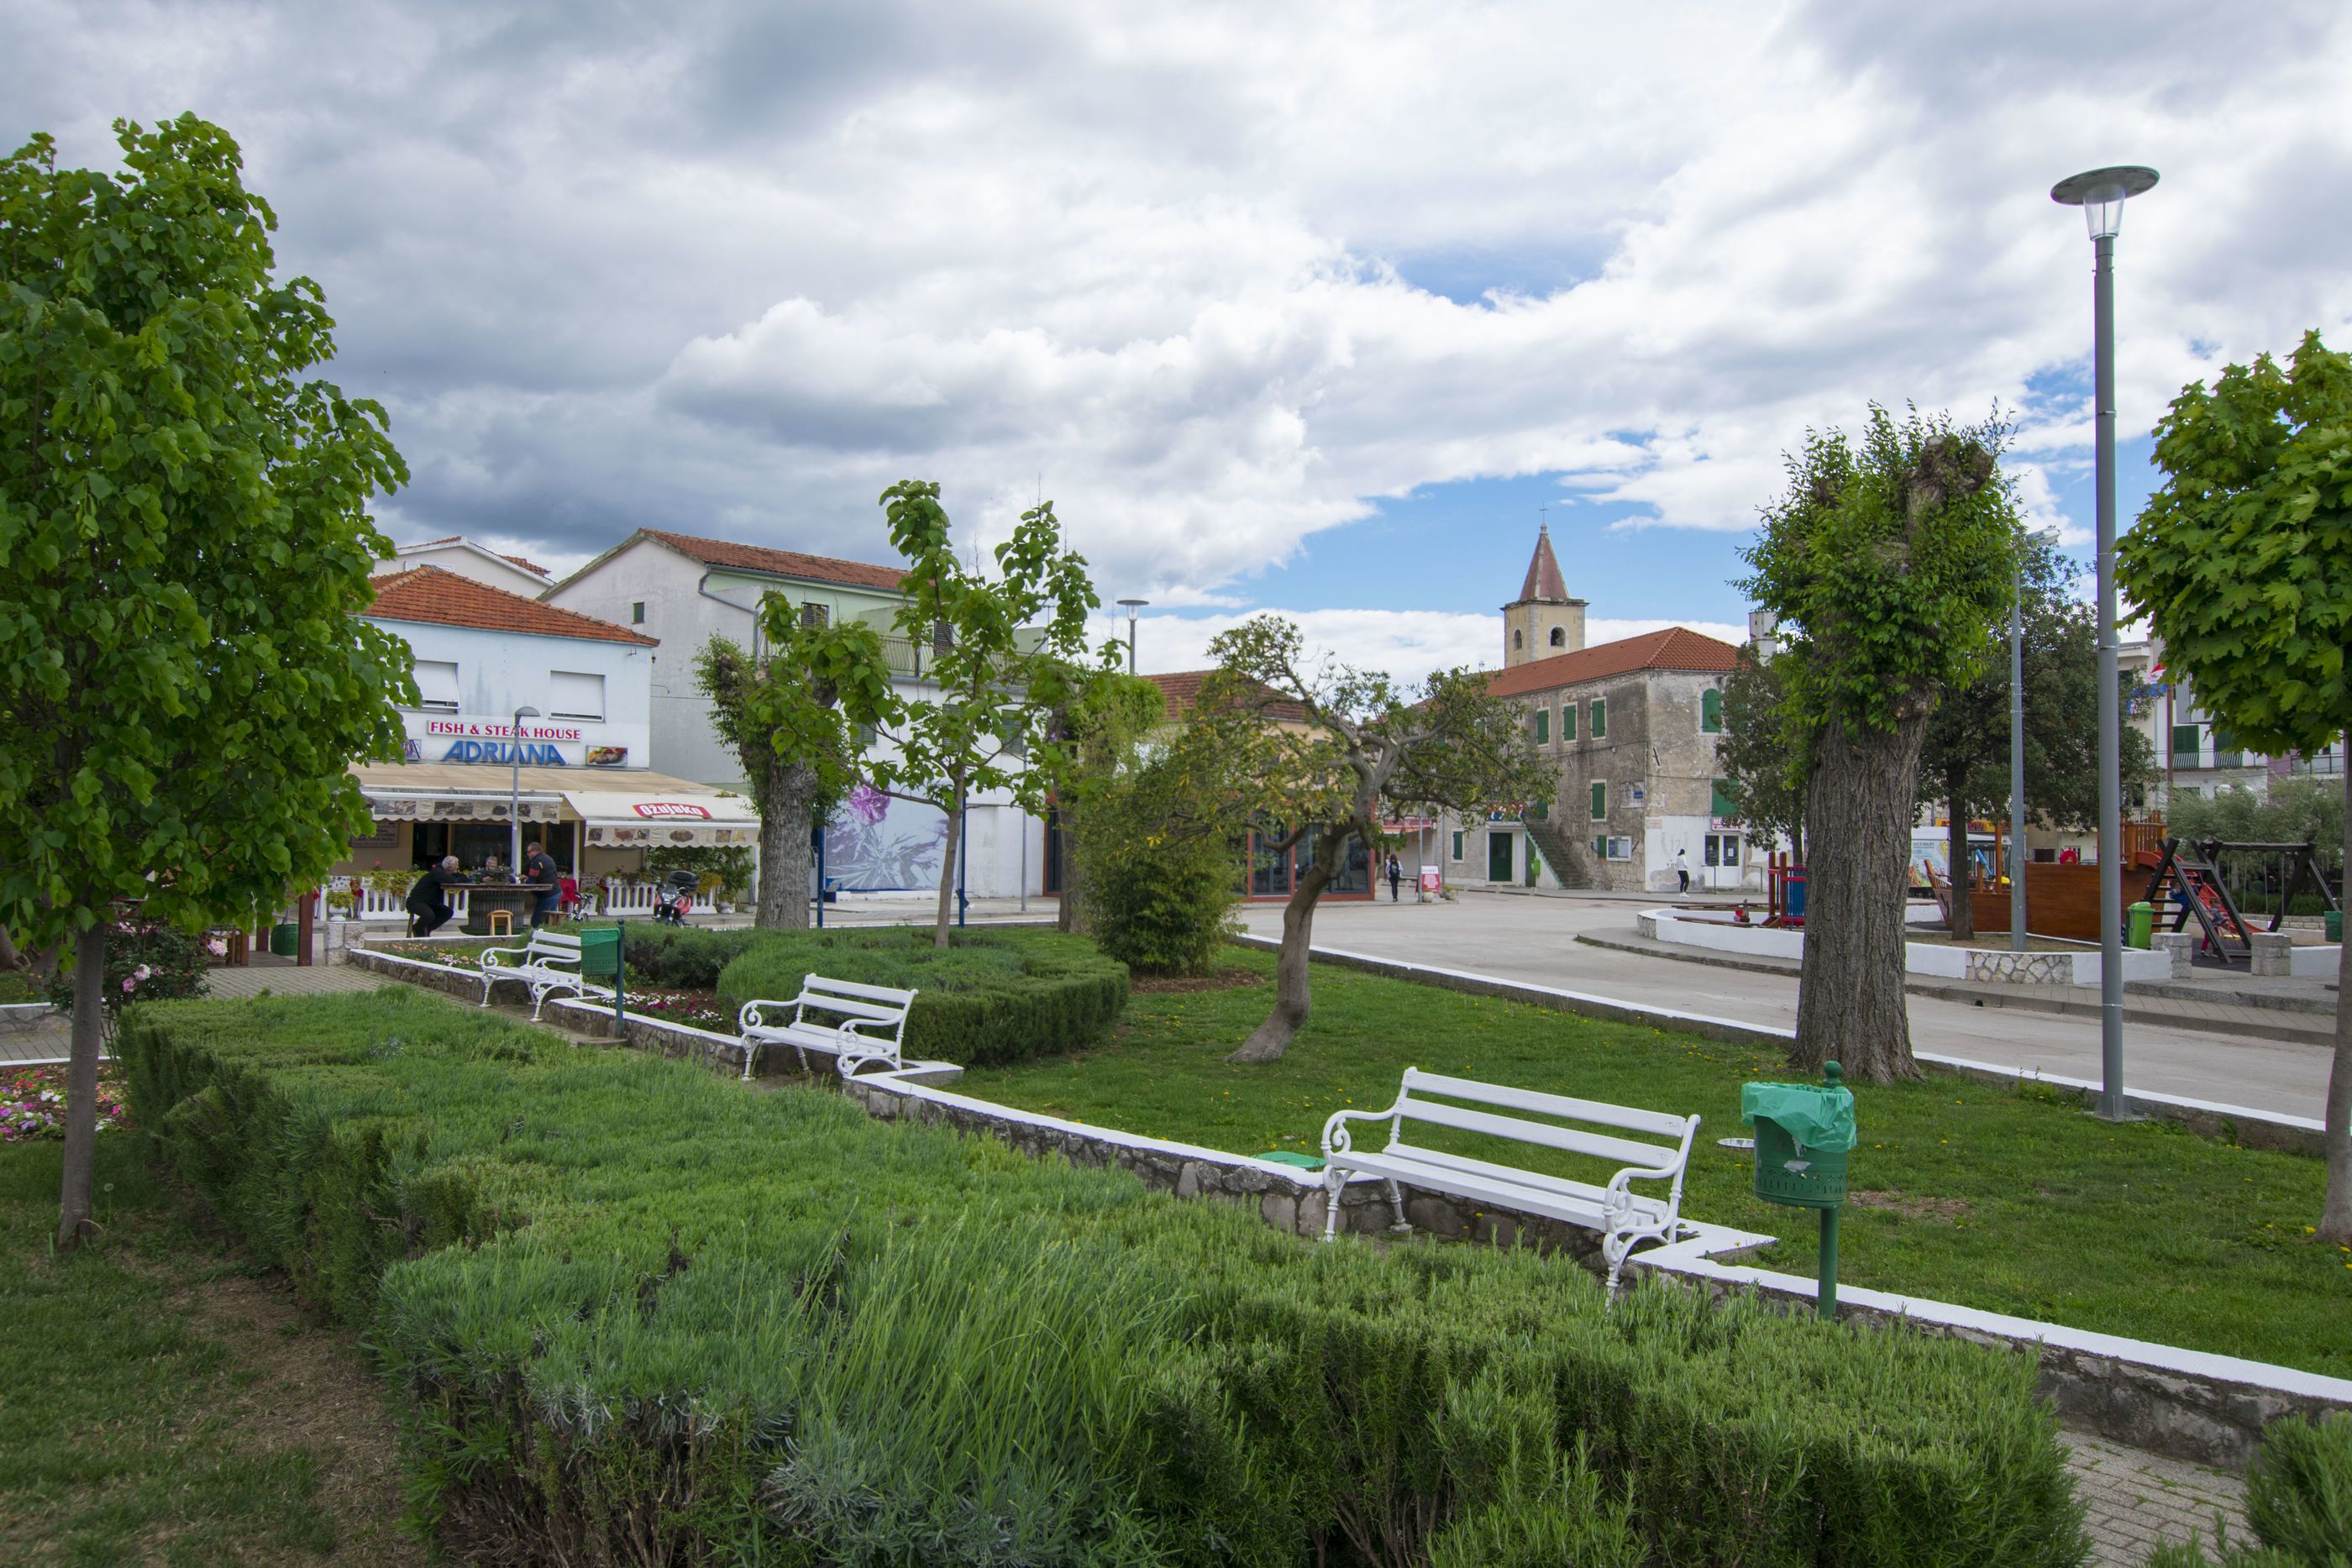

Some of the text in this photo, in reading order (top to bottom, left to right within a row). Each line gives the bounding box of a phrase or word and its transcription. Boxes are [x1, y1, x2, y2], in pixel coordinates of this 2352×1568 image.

[430, 721, 464, 734] FISH
[470, 725, 480, 735] &
[534, 728, 580, 739] HOUSE
[443, 740, 566, 765] ADRIANA
[639, 804, 704, 815] Ožujsko
